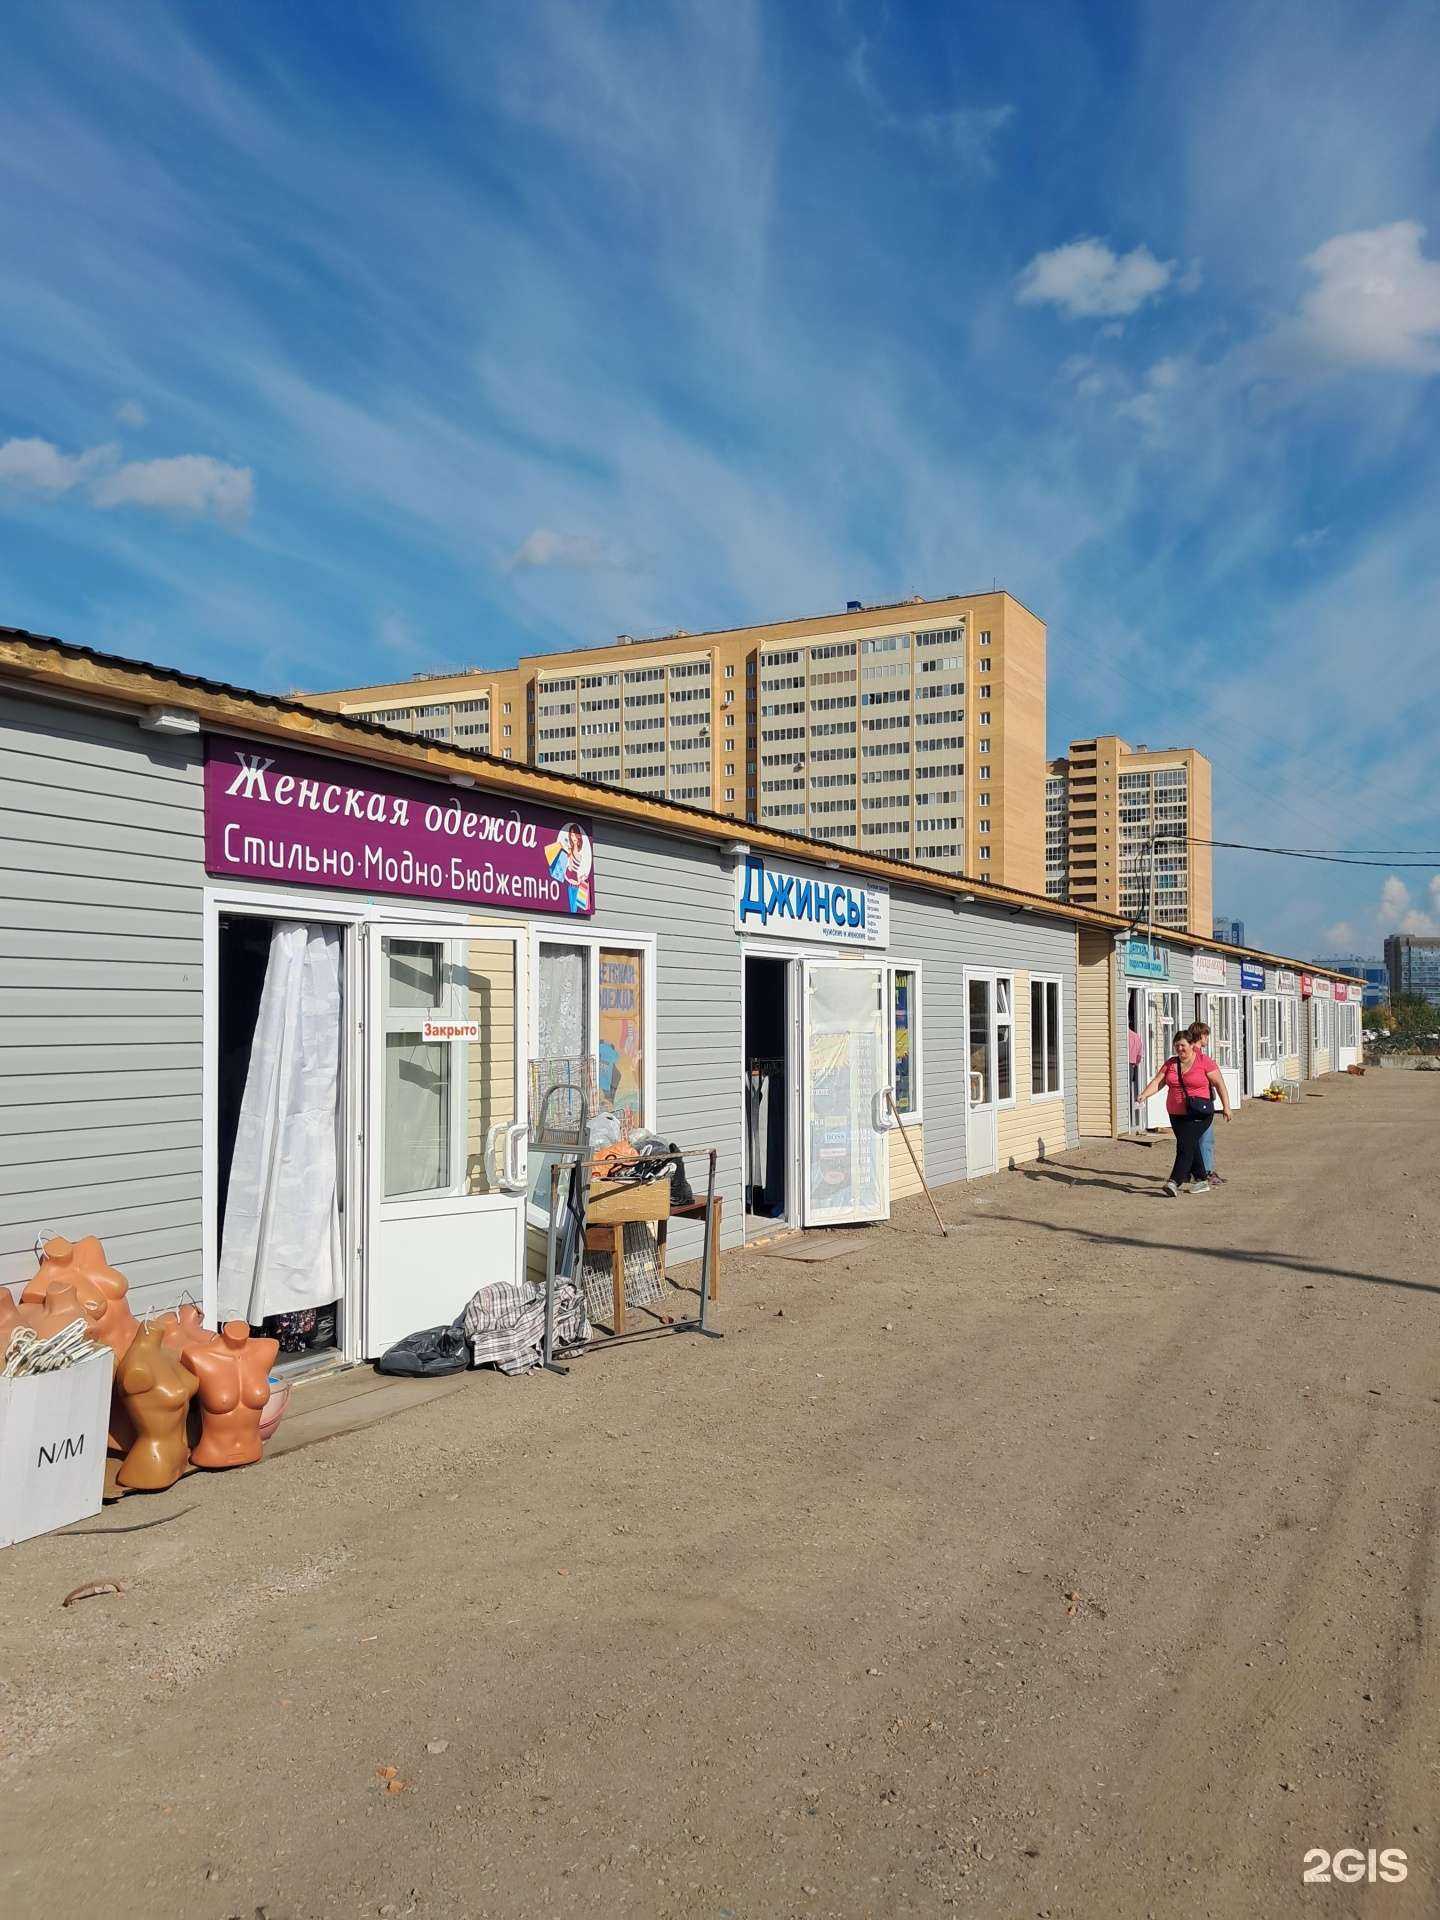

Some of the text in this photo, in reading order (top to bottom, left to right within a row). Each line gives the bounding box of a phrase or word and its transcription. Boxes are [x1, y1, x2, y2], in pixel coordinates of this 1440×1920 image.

[224, 752, 538, 850] Женская одежда
[424, 1023, 477, 1039] Закрыто
[37, 1433, 85, 1468] N/M
